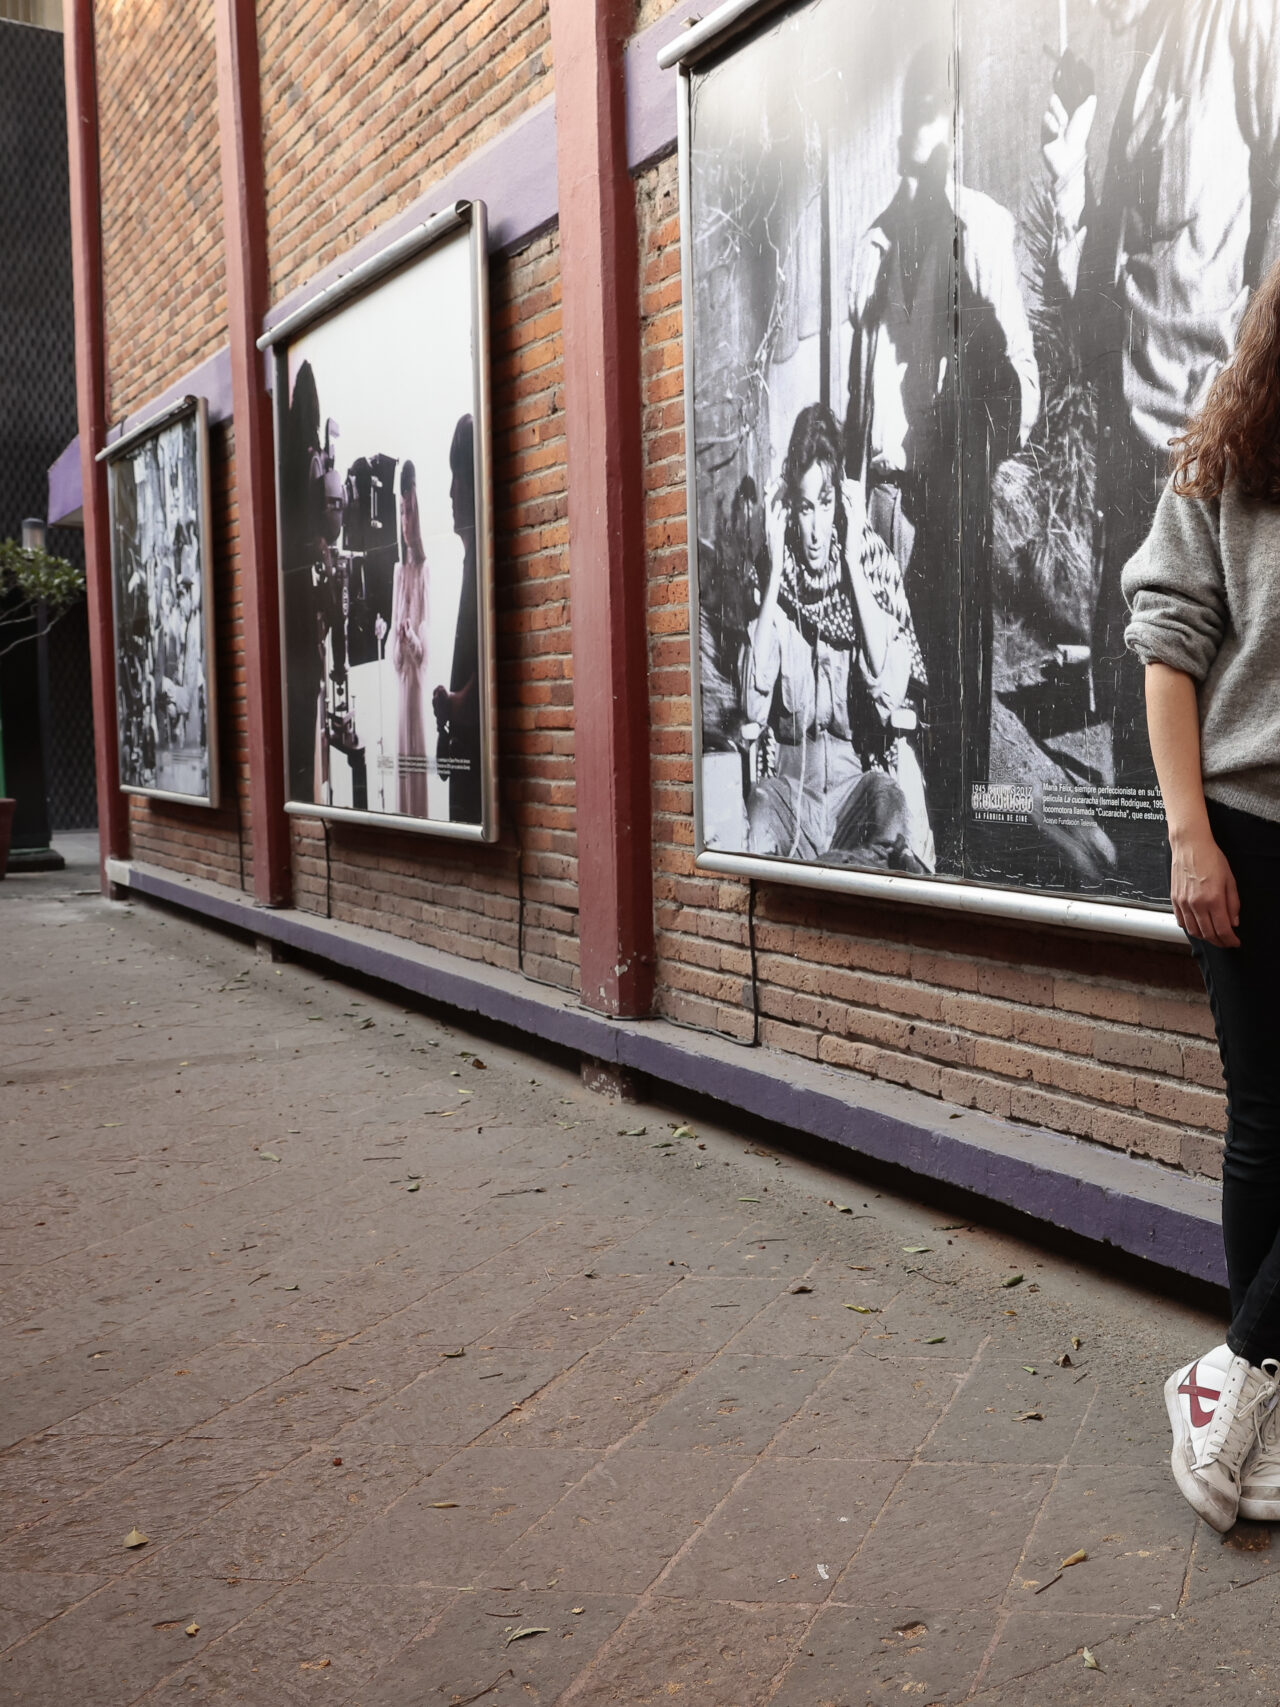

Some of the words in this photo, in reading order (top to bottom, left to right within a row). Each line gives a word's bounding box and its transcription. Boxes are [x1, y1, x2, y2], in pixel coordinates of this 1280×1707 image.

[972, 784, 986, 793] 1945
[1016, 786, 1033, 795] 2017
[1074, 785, 1096, 793] siempre
[1097, 786, 1136, 795] perfeccionista
[1043, 805, 1072, 814] locomotora
[1074, 807, 1094, 815] llamada
[1132, 812, 1143, 820] que
